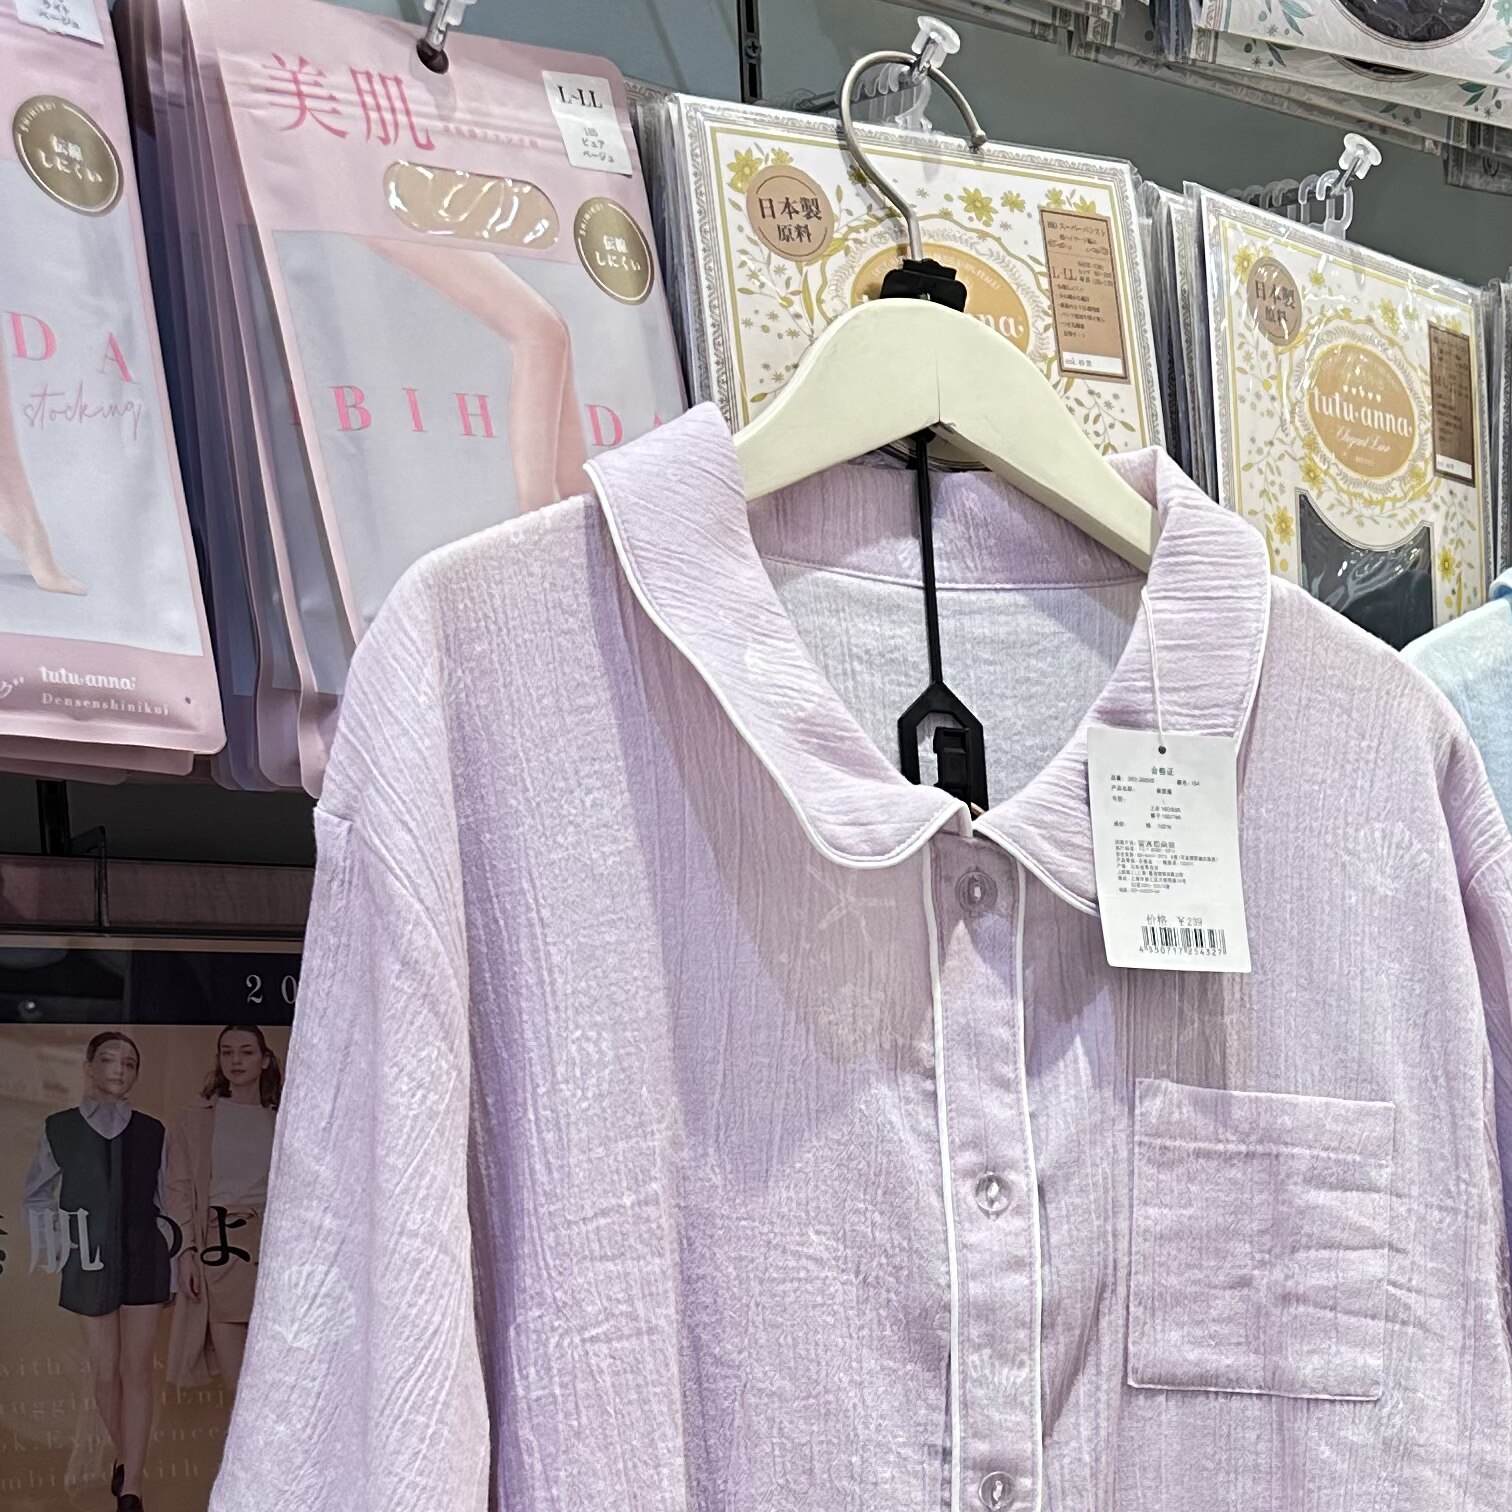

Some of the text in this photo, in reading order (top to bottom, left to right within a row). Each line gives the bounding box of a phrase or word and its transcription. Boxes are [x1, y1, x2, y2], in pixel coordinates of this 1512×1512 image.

[262, 52, 436, 151] 美肌
[758, 196, 822, 221] 日本製
[777, 223, 812, 243] 原料
[23, 380, 142, 442] stocking
